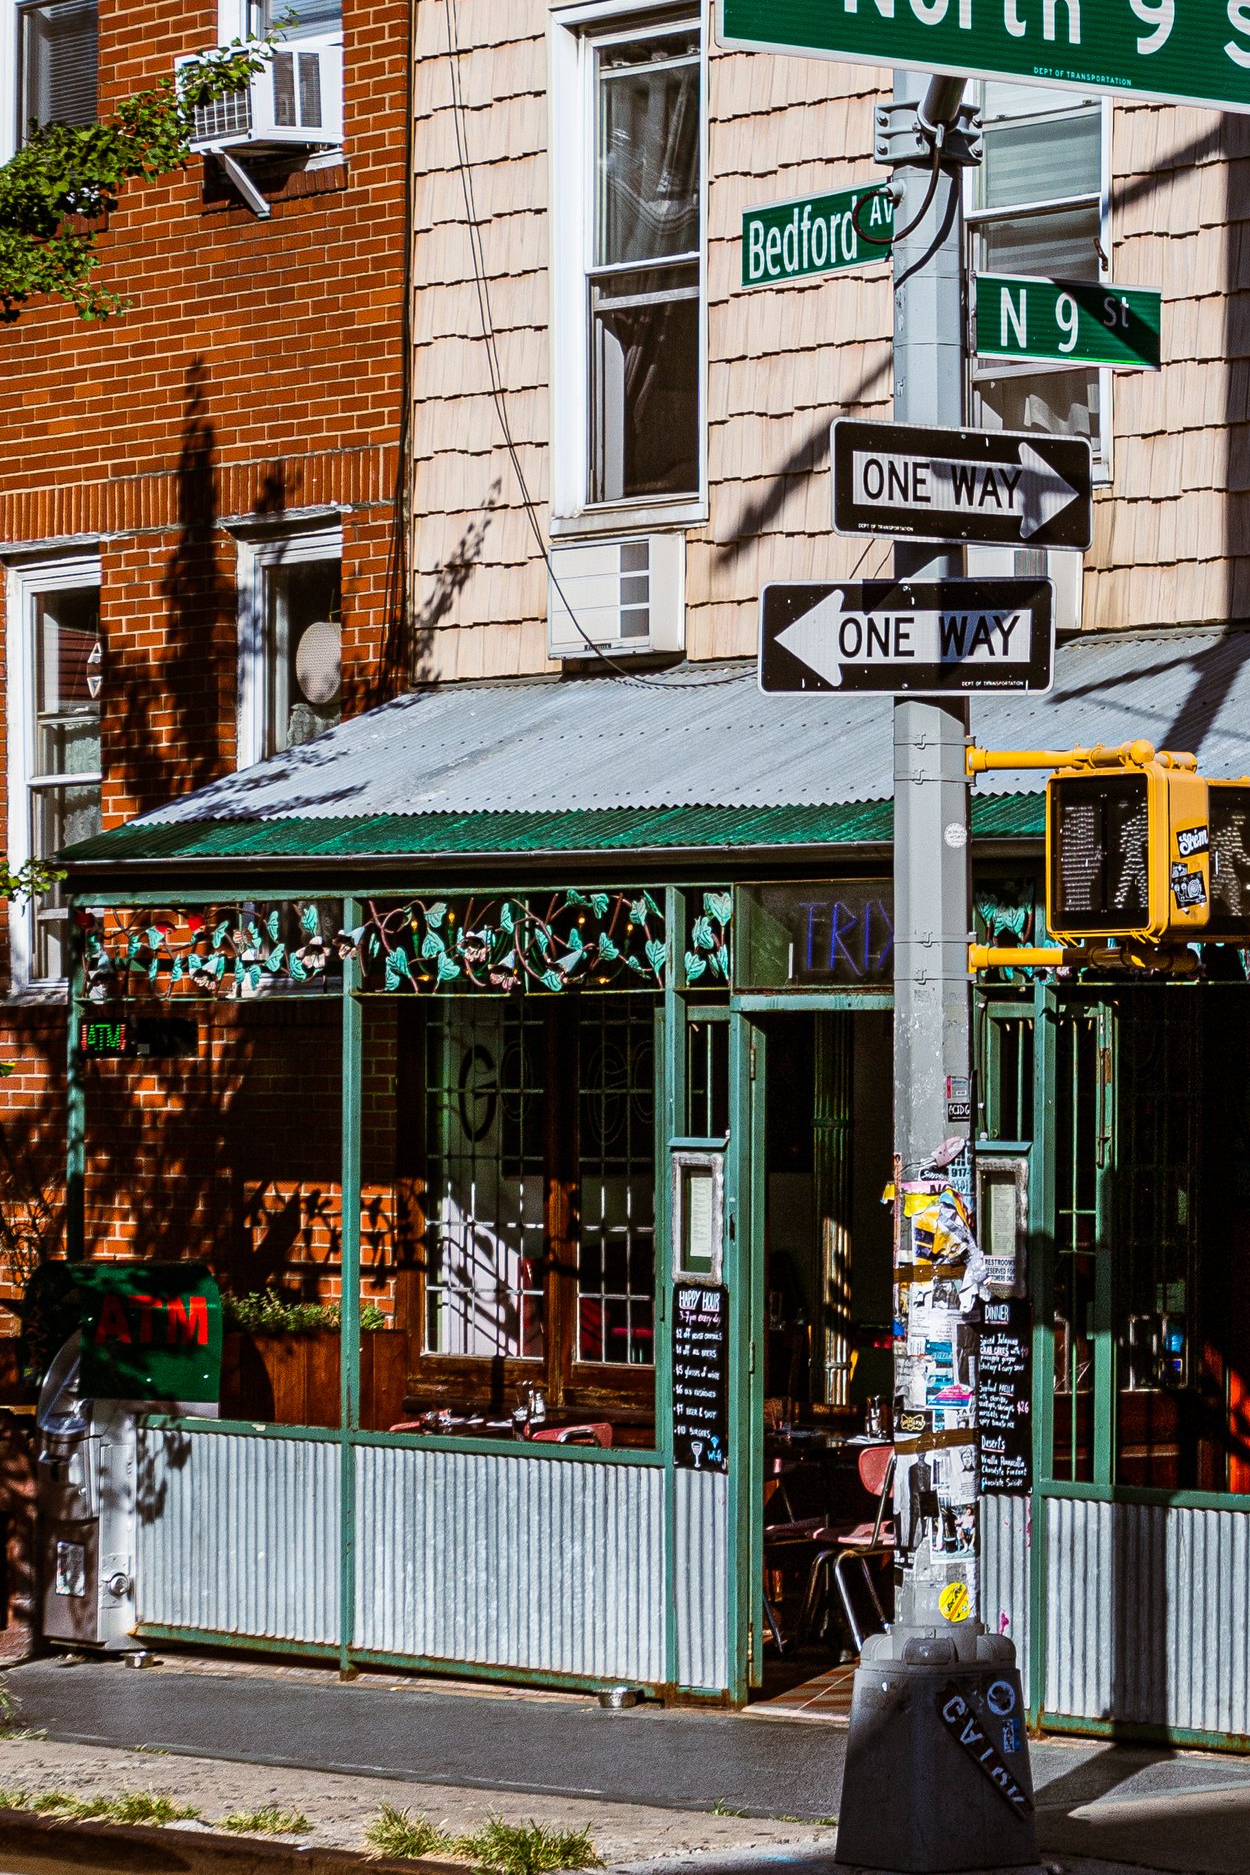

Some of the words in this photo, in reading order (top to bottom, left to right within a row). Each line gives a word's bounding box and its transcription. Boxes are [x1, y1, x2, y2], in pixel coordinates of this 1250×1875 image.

[1033, 66, 1053, 76] DEPT
[1054, 69, 1065, 78] OF
[1066, 71, 1132, 86] TRANSPORTATION
[749, 194, 858, 280] Bedford
[869, 196, 894, 227] Av
[1000, 286, 1027, 349] N
[1055, 291, 1079, 353] 9
[1102, 296, 1130, 328] St
[862, 457, 932, 504] ONE
[950, 465, 1023, 510] WAY
[838, 616, 916, 659] ONE
[938, 615, 1022, 659] WAY
[87, 1023, 121, 1051] ATM
[95, 1294, 209, 1346] ATM
[679, 1290, 701, 1309] HAPPY
[702, 1291, 721, 1311] HOUR
[1017, 1400, 1029, 1415] $26
